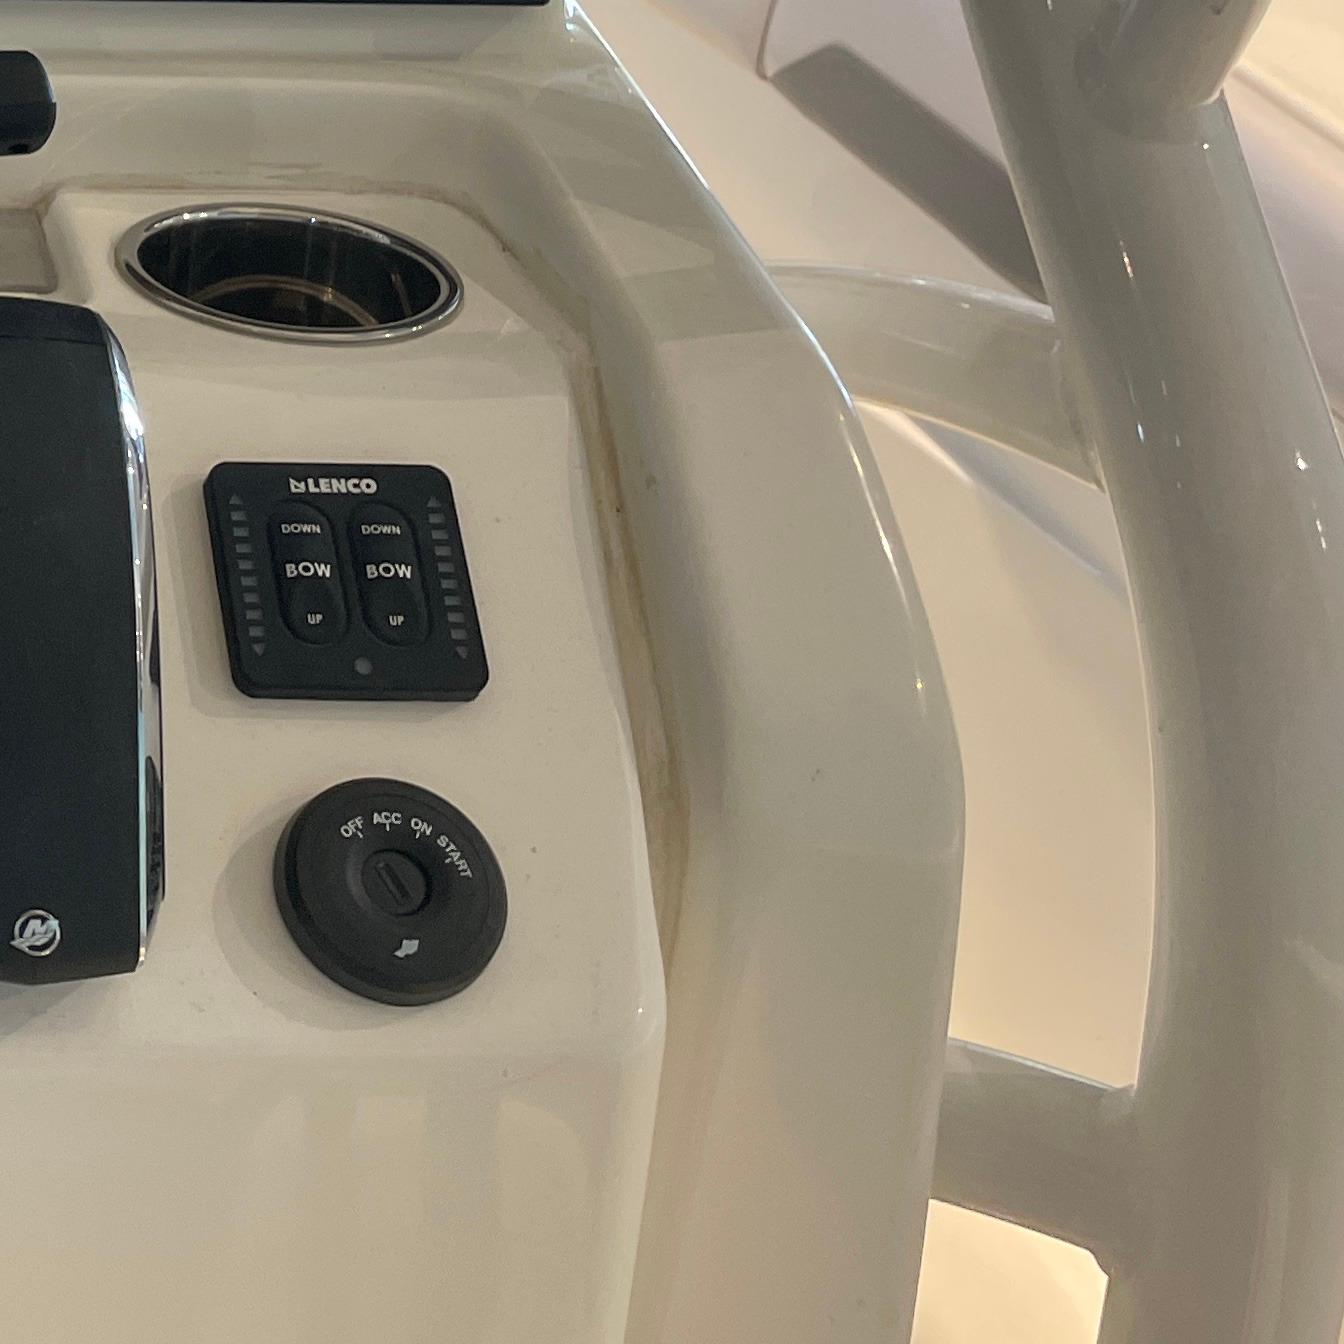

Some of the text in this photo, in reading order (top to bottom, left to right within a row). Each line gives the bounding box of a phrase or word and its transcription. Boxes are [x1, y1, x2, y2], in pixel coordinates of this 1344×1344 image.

[307, 477, 378, 495] LENCO
[281, 523, 321, 535] DOWN
[361, 524, 401, 536] DOWN
[285, 561, 332, 579] BOW
[366, 562, 412, 580] BOW
[307, 613, 323, 625] UP
[389, 615, 405, 627] UP
[340, 812, 473, 879] OFF ACC ON START
